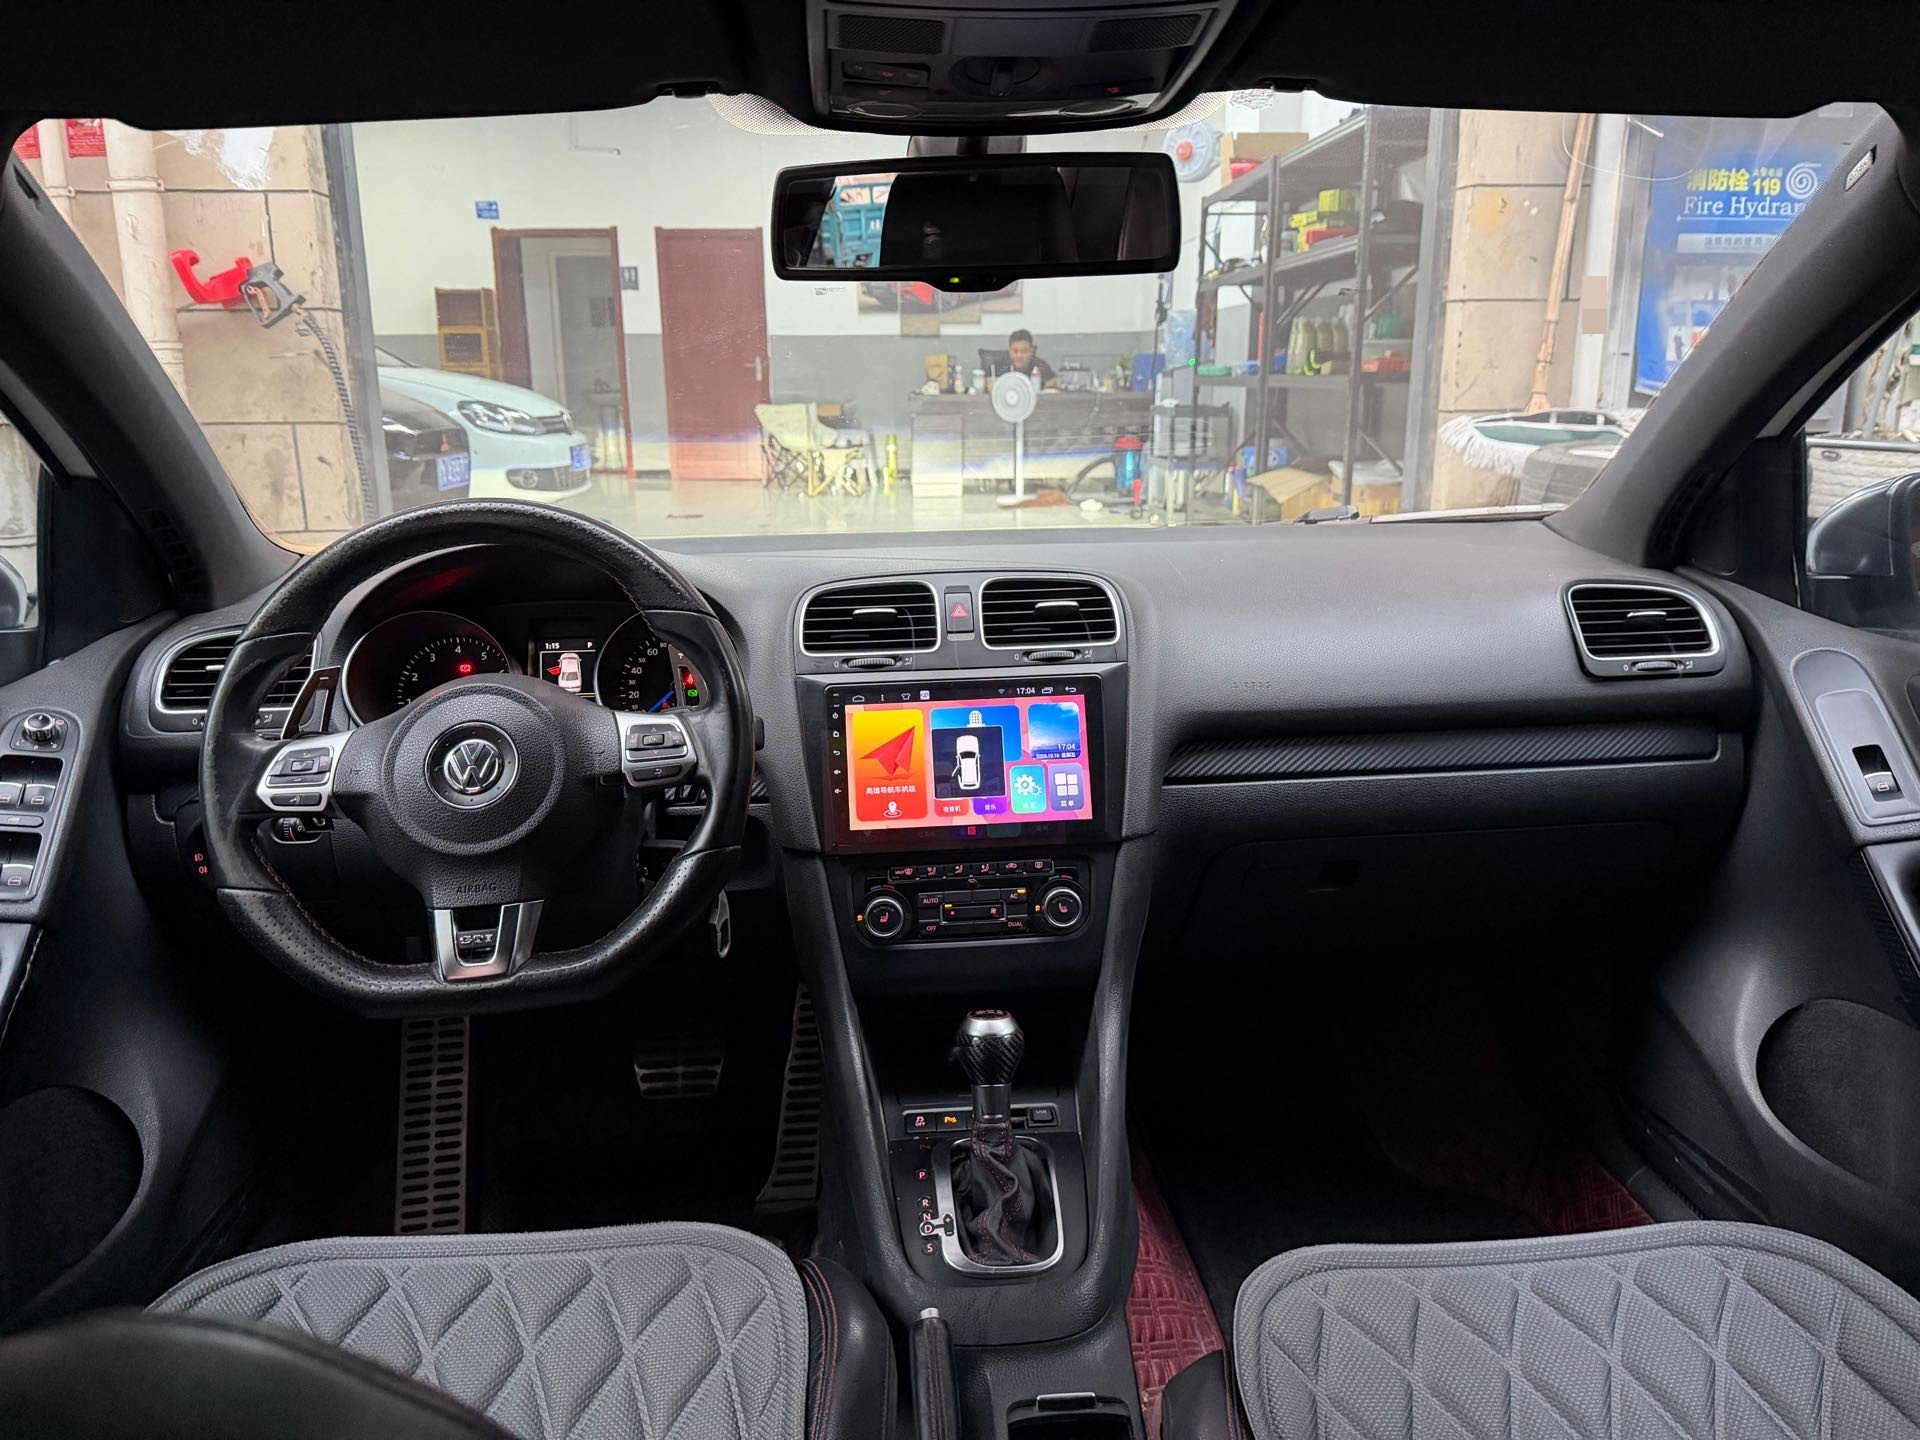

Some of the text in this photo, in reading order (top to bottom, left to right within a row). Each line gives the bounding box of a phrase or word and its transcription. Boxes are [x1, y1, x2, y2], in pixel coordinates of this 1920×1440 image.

[1686, 168, 1750, 192] 消防栓
[1753, 178, 1782, 196] 119
[1684, 196, 1724, 215] Fire
[455, 645, 462, 654] 4
[545, 642, 560, 650] 1:15
[481, 652, 488, 661] 5
[647, 648, 658, 656] 60
[430, 653, 436, 662] 3
[631, 667, 642, 675] 40
[411, 673, 419, 681] 2
[628, 691, 640, 699] 20
[1016, 687, 1036, 695] 17:04
[456, 883, 497, 894] AIRBAG
[459, 934, 494, 944] GTI
[919, 1171, 926, 1179] P
[923, 1213, 931, 1221] N
[924, 1224, 933, 1233] D
[927, 1244, 934, 1253] S
